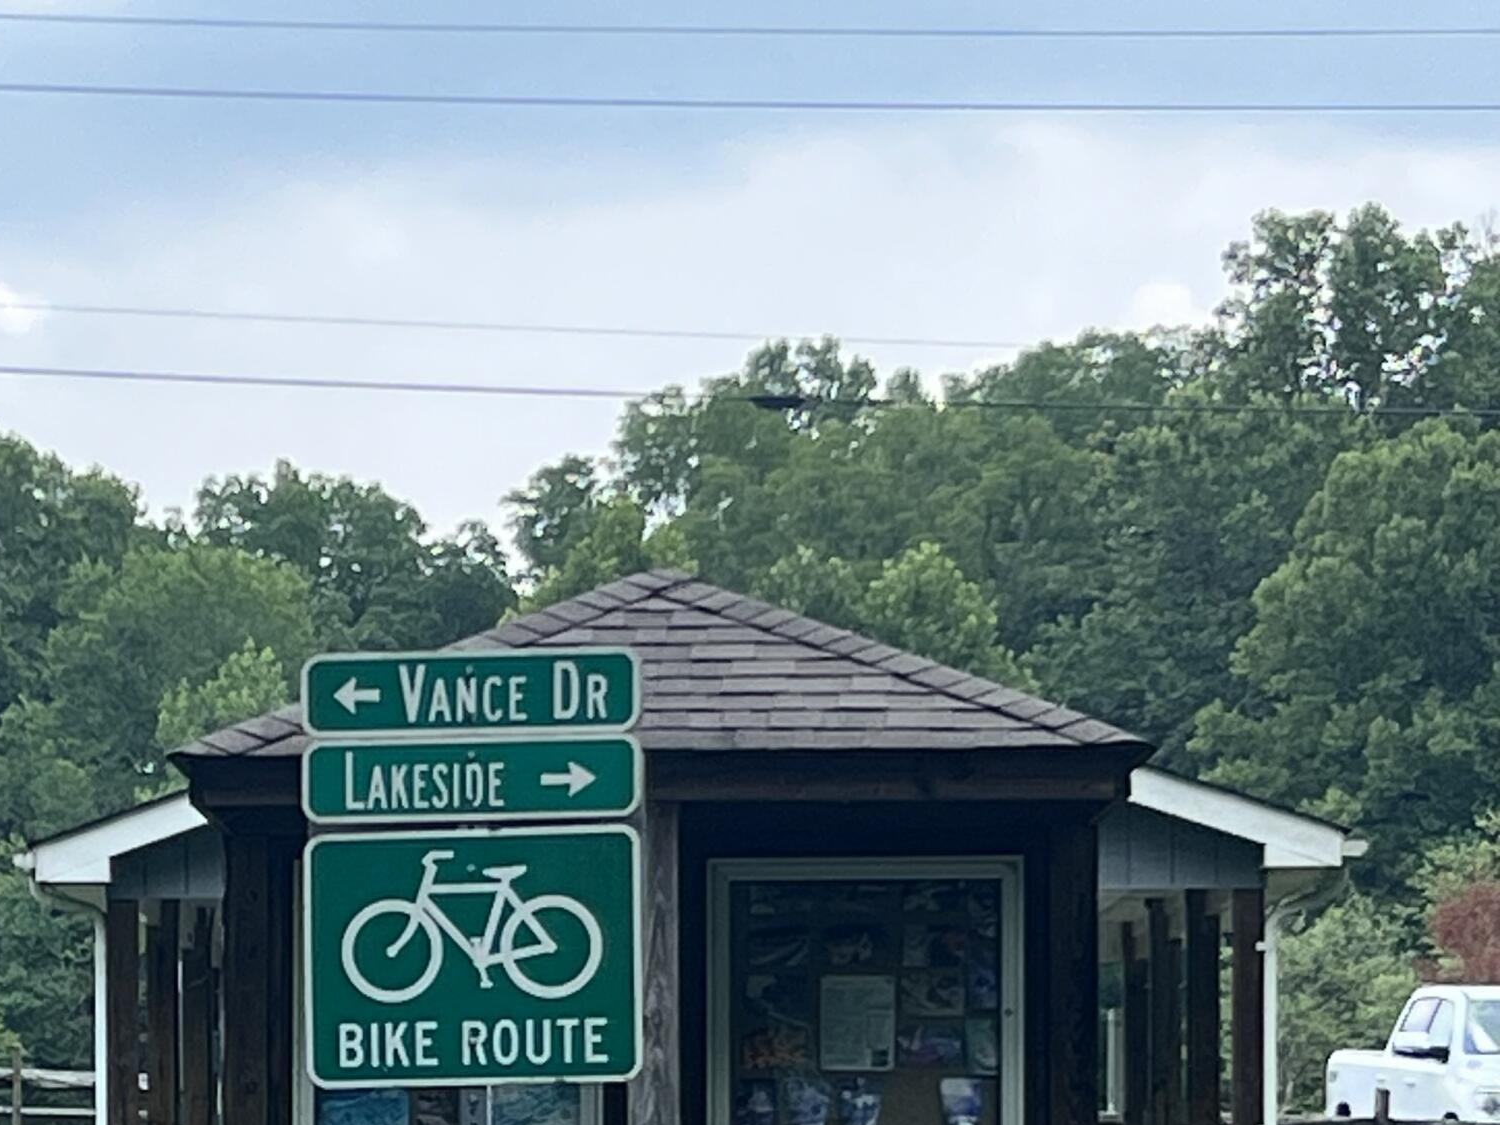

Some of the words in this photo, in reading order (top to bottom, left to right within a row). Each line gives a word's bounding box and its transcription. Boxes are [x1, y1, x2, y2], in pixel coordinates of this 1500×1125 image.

[399, 663, 528, 723] VANCE
[552, 660, 609, 720] DR
[344, 751, 505, 811] LAKESIDE
[338, 1021, 440, 1069] BIKE
[461, 1017, 609, 1067] ROUTE
